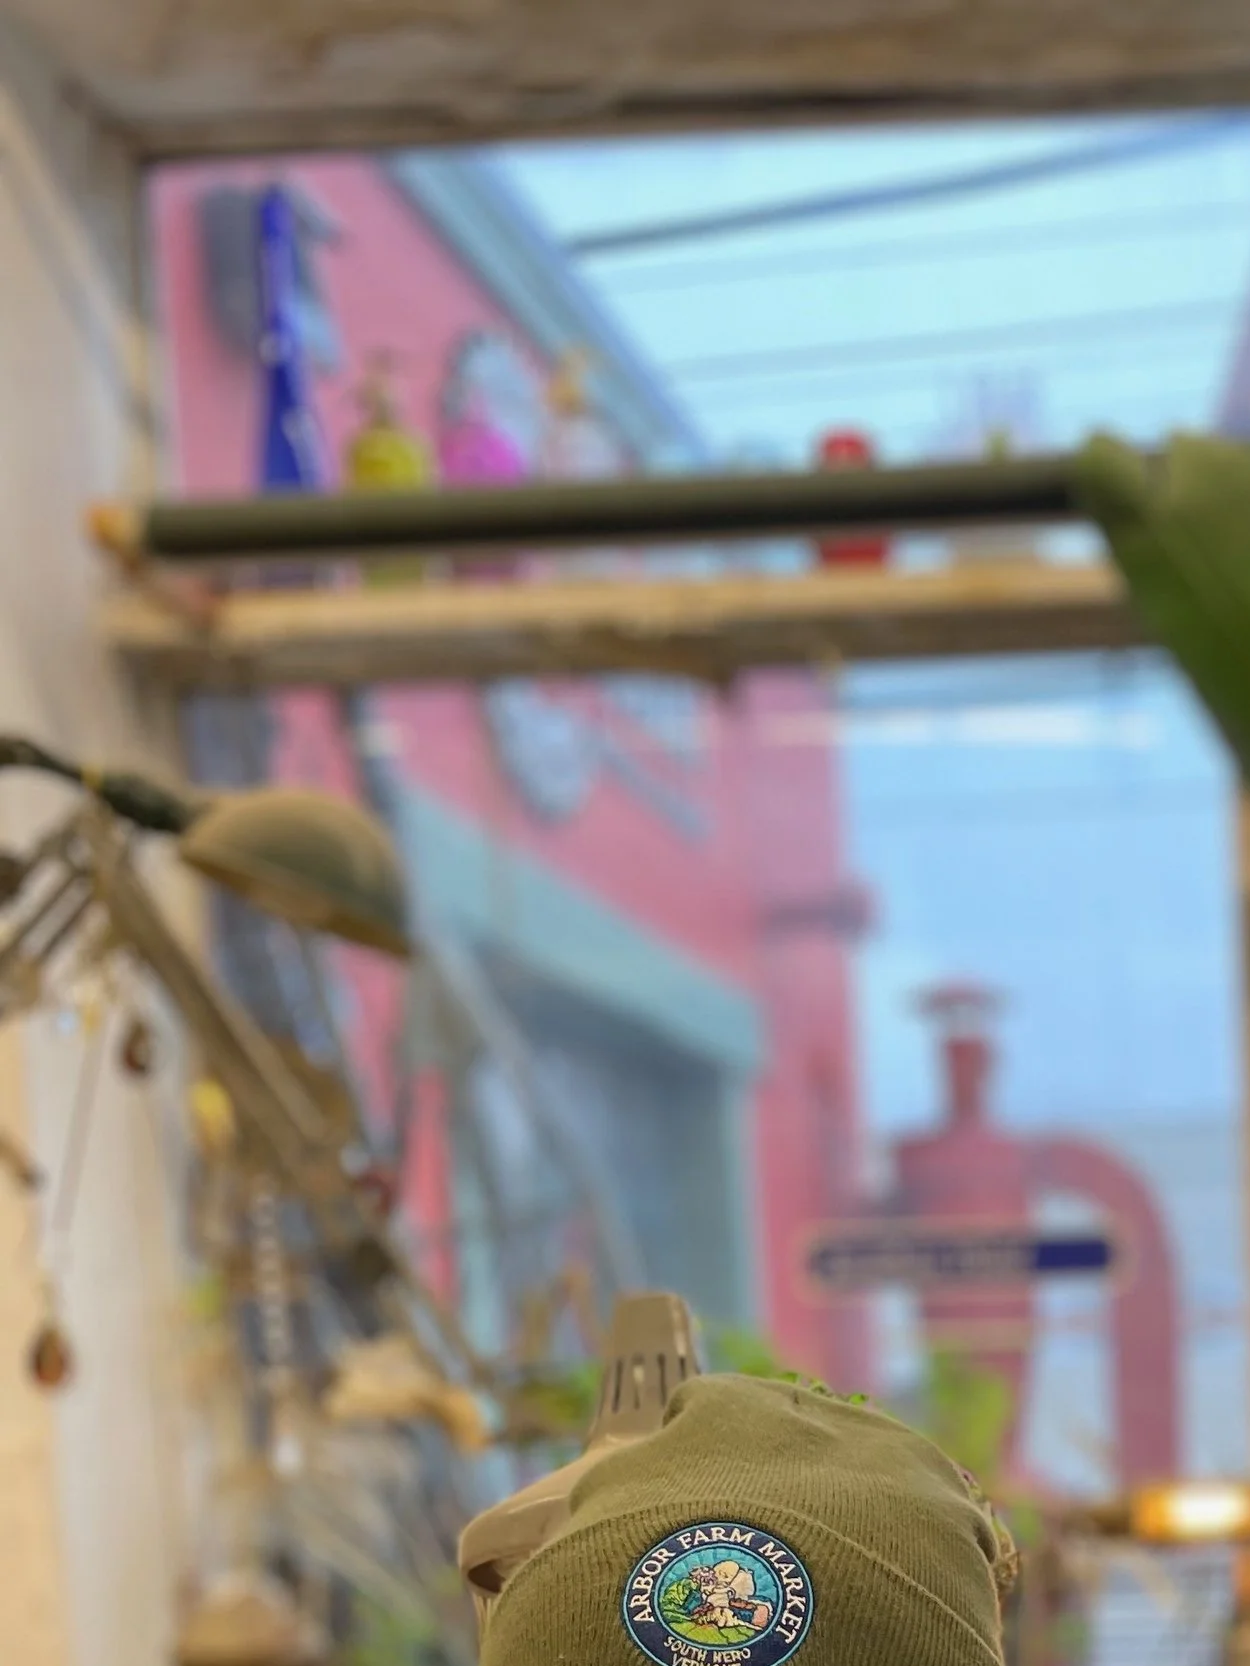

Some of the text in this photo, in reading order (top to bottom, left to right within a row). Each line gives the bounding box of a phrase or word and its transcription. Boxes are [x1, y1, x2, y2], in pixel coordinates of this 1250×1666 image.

[627, 1527, 806, 1644] ARBOR FARM MARKET
[663, 1635, 751, 1664] SOUTH HERO
